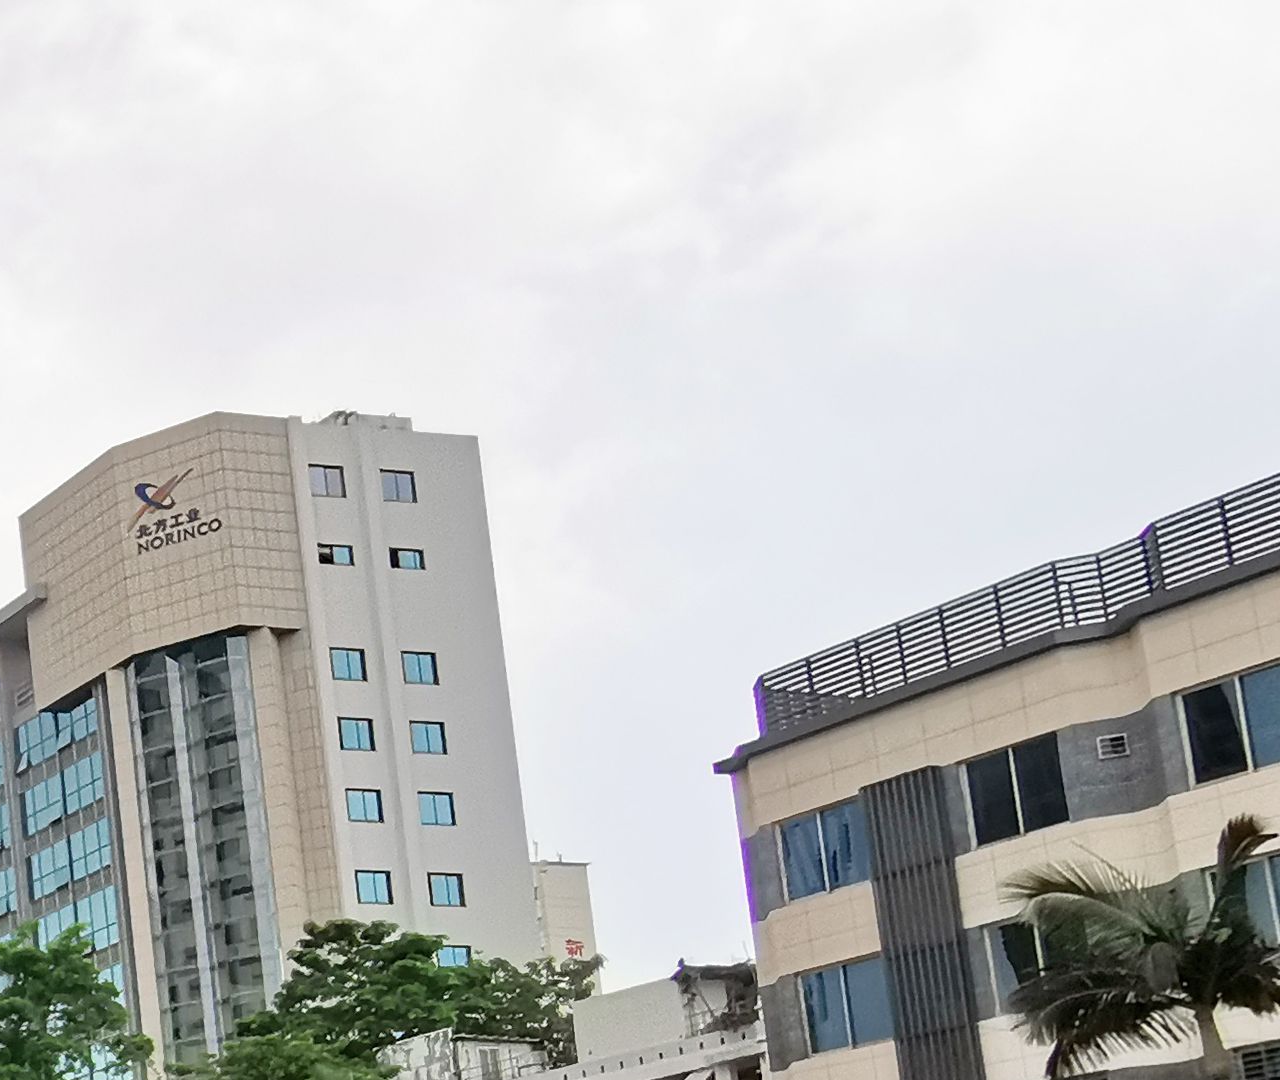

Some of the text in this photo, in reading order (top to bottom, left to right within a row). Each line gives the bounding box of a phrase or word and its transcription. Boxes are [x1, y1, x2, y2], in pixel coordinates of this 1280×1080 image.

[137, 508, 200, 539] 北方工业
[137, 518, 222, 554] NORINCO
